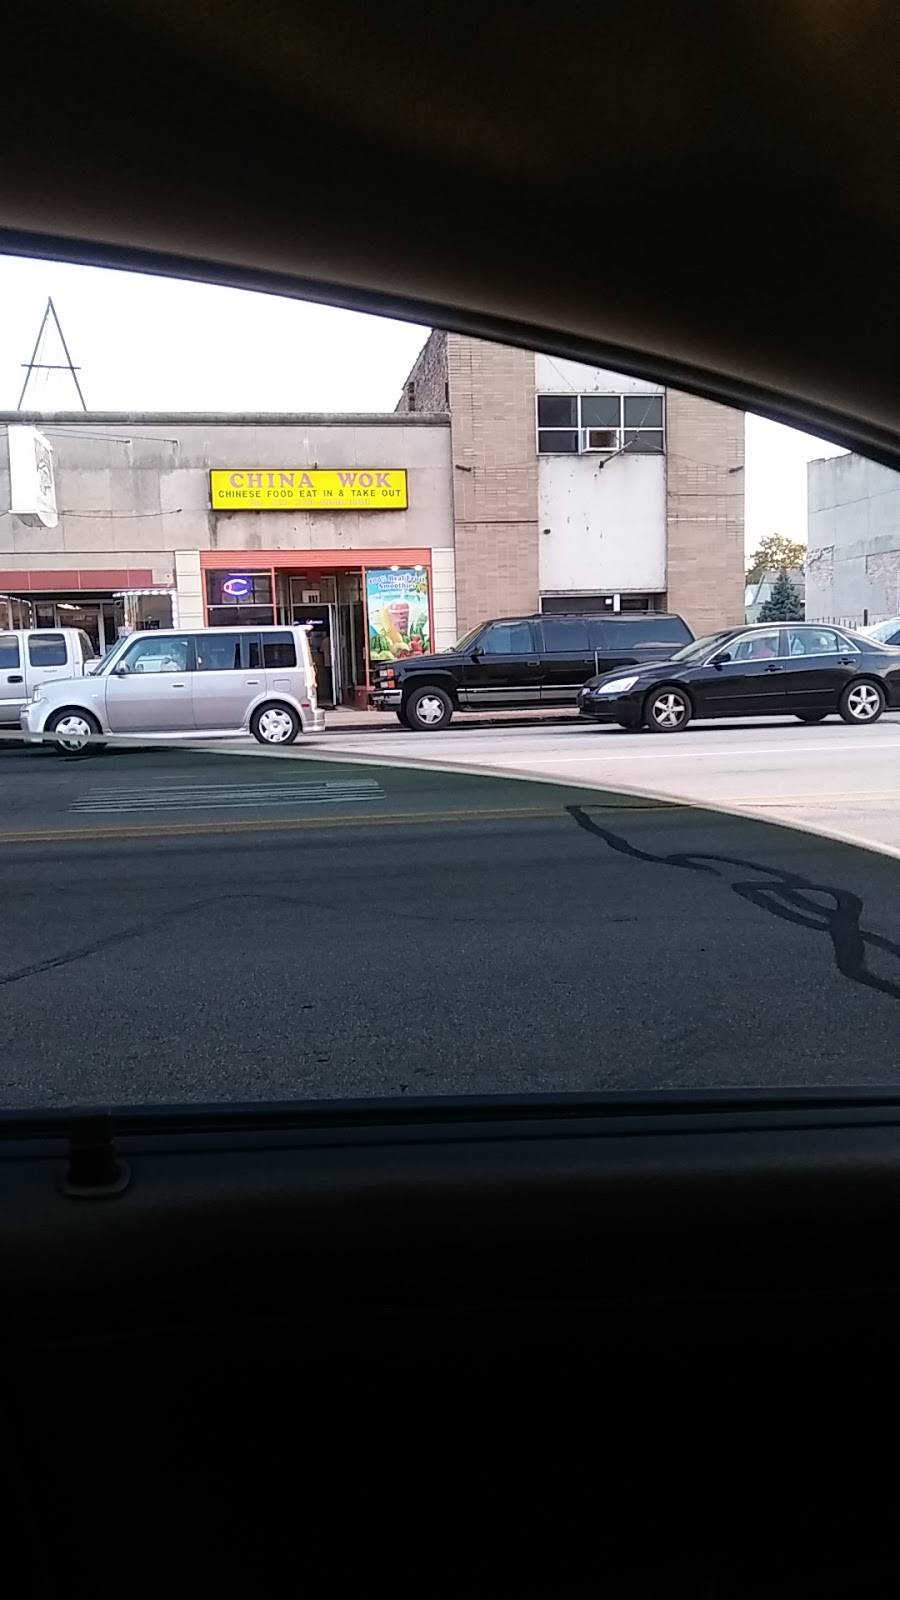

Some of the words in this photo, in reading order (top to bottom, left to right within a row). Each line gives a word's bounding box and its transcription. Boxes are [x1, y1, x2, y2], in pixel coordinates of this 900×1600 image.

[229, 472, 314, 489] CHINA
[337, 472, 393, 488] WOK
[218, 490, 261, 498] CHINESE
[267, 490, 294, 498] FOOD
[299, 489, 318, 498] EAT
[323, 489, 334, 497] IN
[338, 489, 345, 497] &
[351, 489, 376, 497] TAKE
[381, 489, 401, 497] OUT
